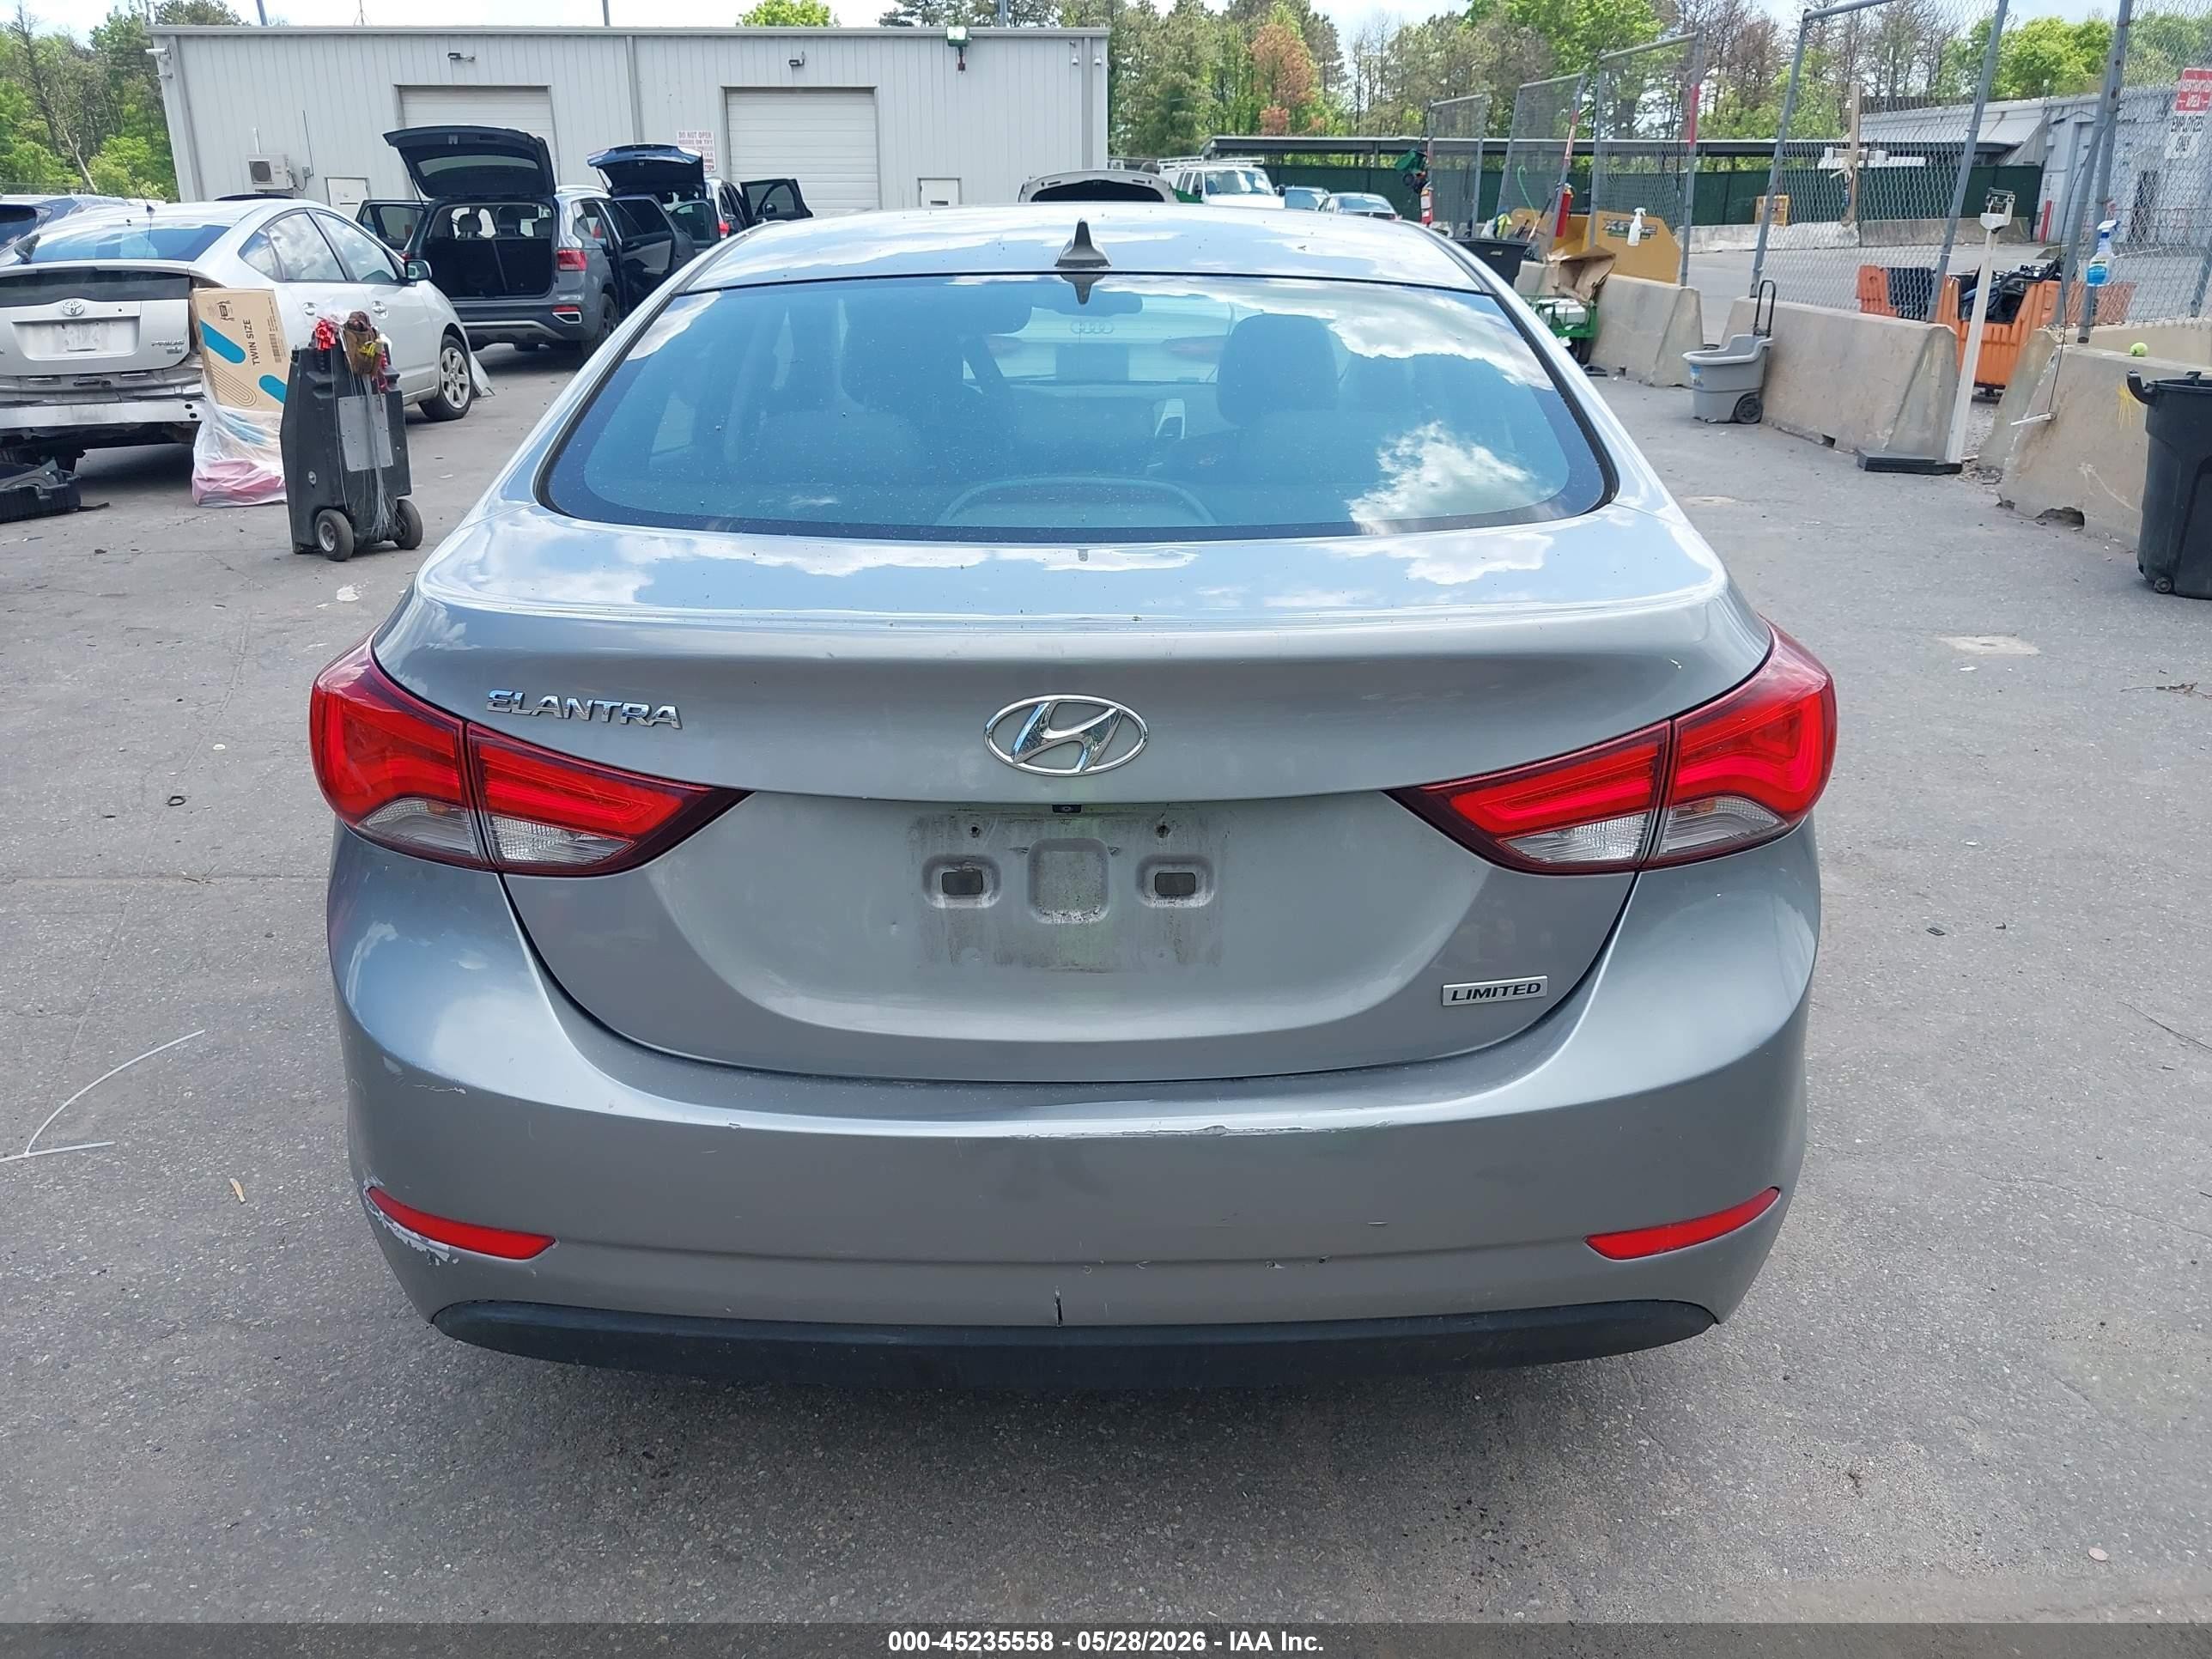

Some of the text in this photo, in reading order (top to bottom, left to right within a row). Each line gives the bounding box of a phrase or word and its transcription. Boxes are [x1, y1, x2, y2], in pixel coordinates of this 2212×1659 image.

[243, 319, 261, 366] TWIN SIZE
[486, 689, 684, 729] ELANTRA
[1451, 982, 1541, 1001] LIMITED
